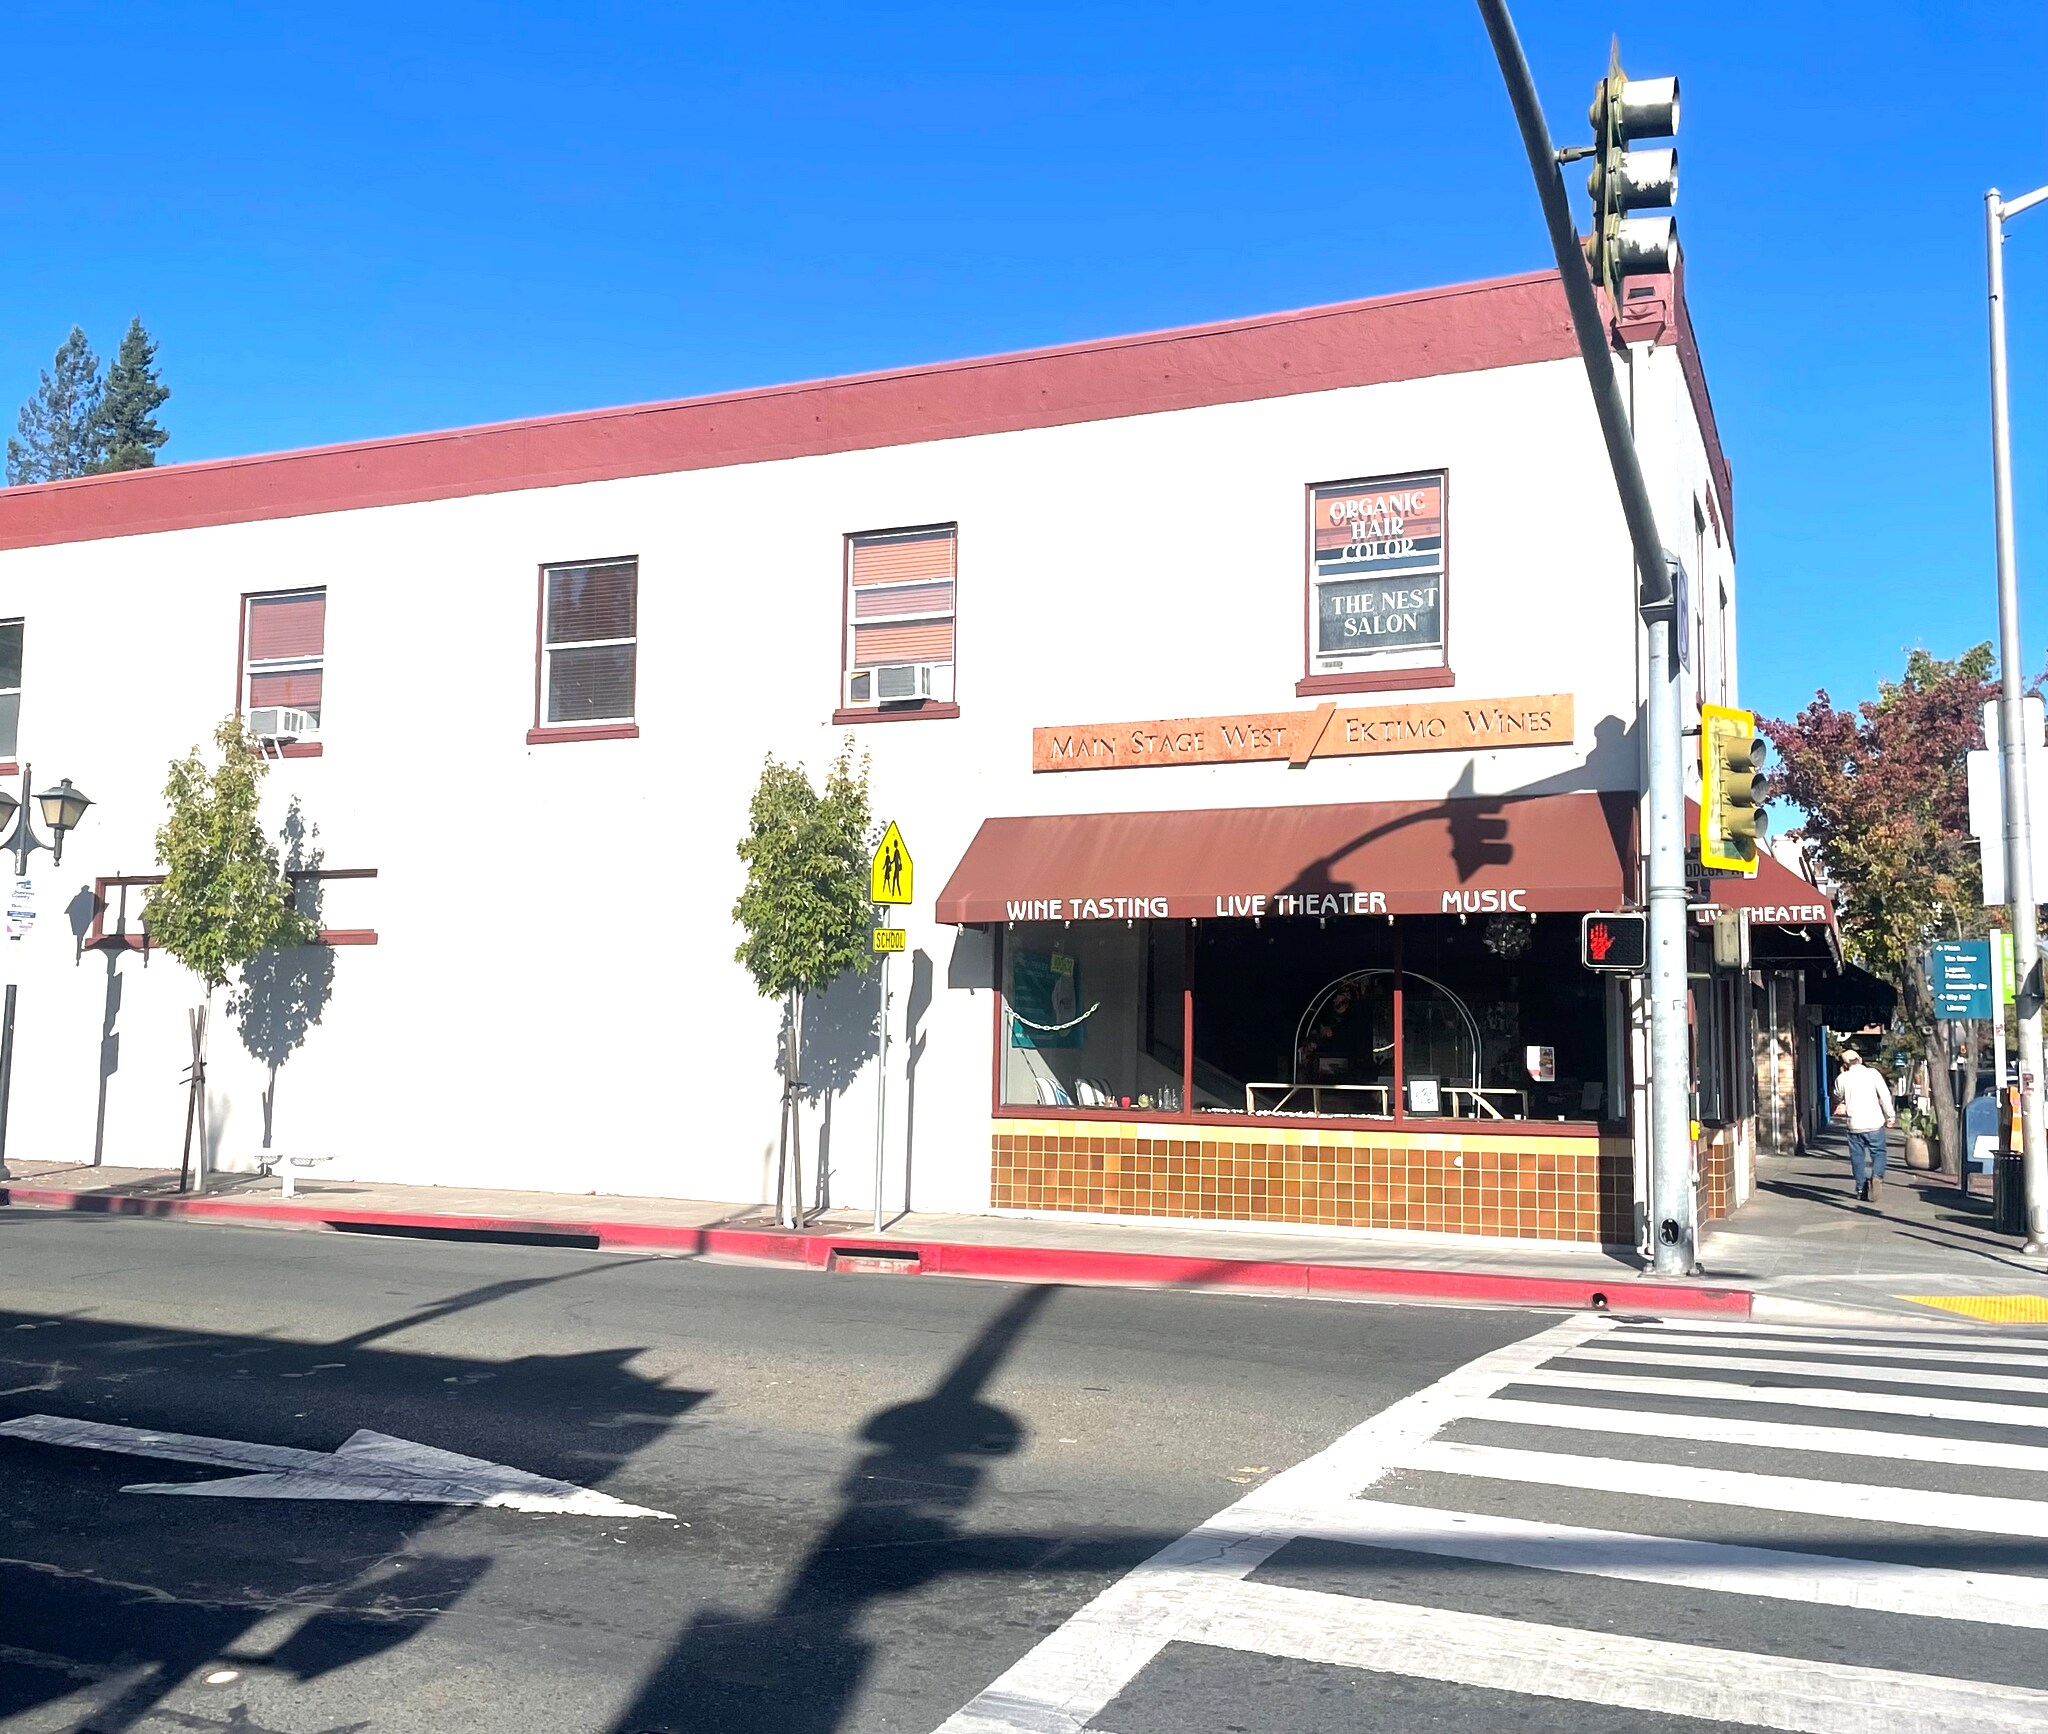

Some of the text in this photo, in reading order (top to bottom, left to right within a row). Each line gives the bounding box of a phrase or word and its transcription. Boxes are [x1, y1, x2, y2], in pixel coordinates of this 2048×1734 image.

[1329, 491, 1426, 520] ORGANIC
[1351, 516, 1405, 541] HAIR
[1342, 538, 1414, 563] COLOR
[1331, 587, 1439, 615] THE NEST
[1344, 613, 1418, 637] SALON
[1006, 889, 1527, 921] WINE TASTING LIVE THEATER MUSIC
[1740, 905, 1827, 922] THEATER
[876, 932, 903, 948] SCHOOL
